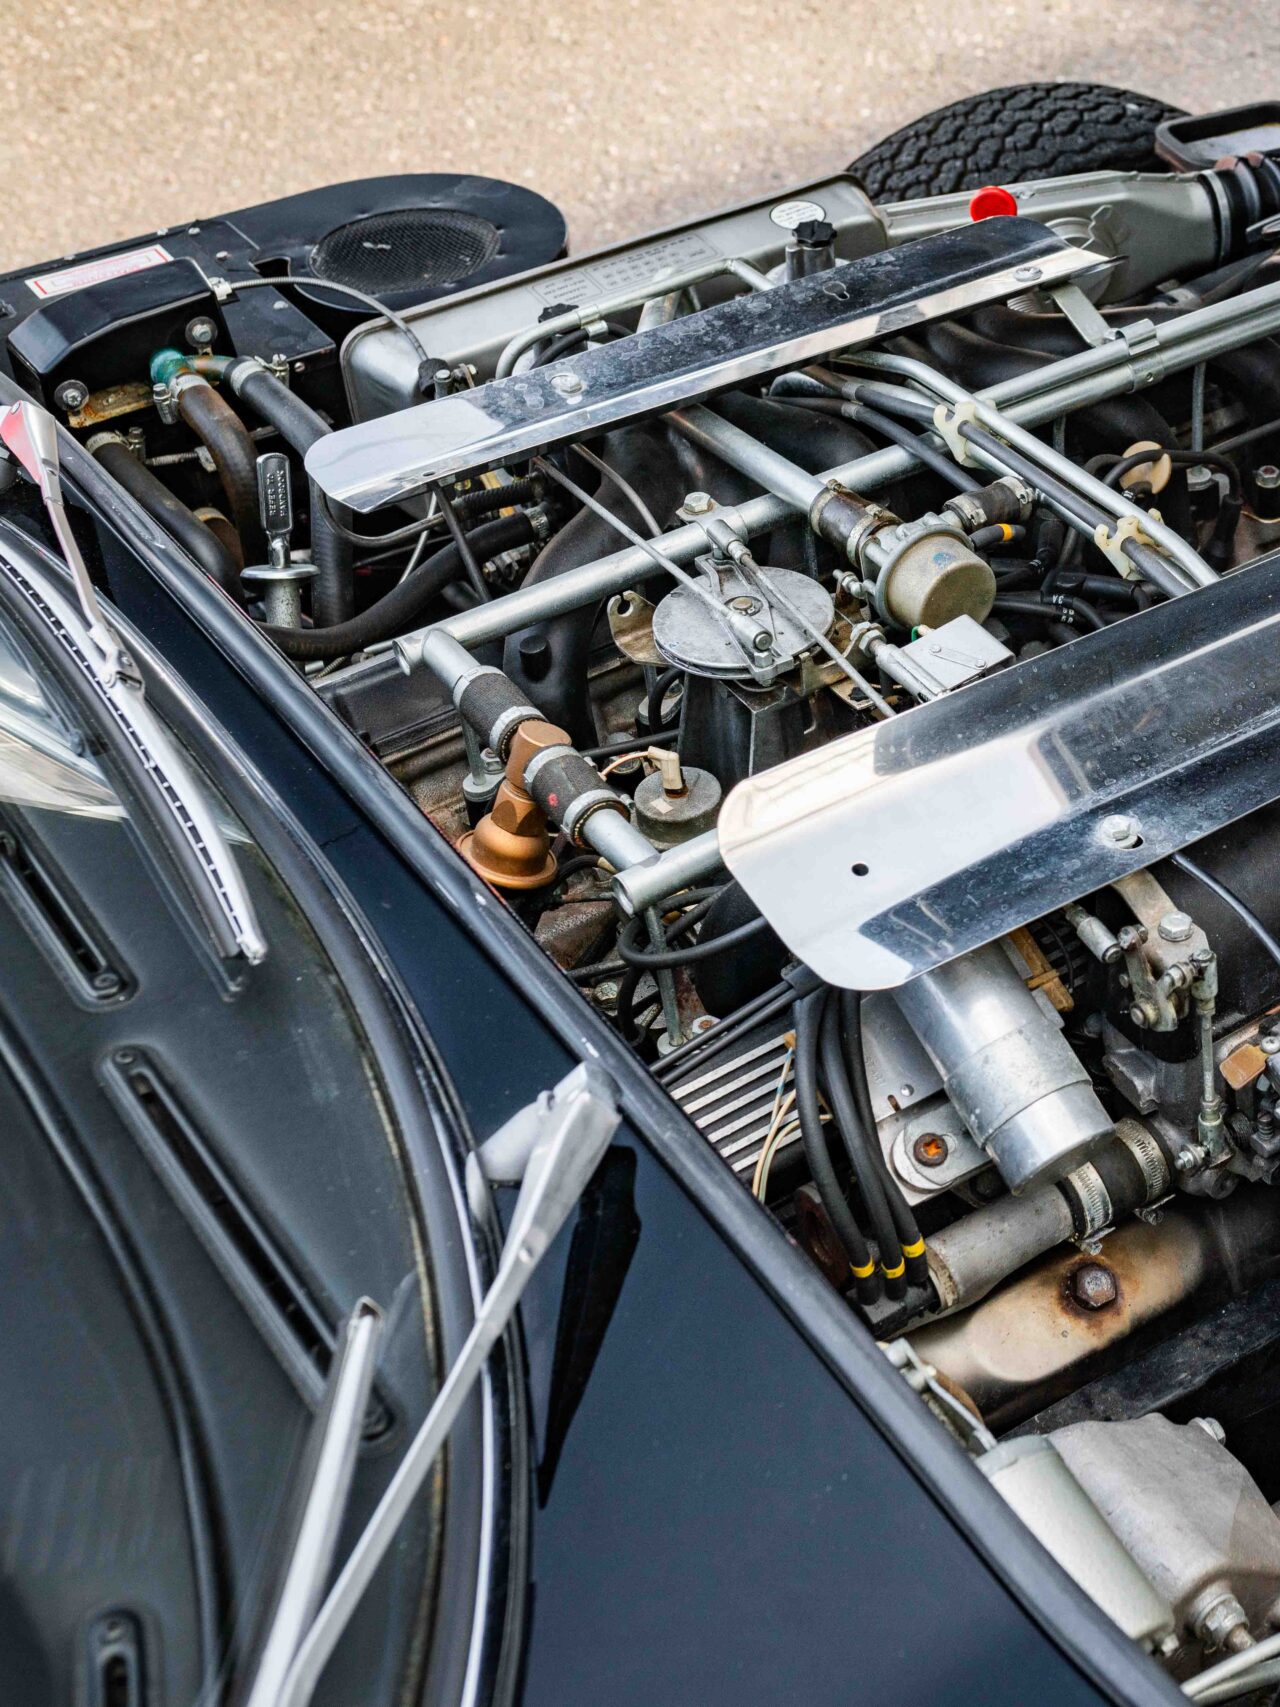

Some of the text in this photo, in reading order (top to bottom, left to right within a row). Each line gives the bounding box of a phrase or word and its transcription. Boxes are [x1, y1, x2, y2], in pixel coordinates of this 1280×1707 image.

[266, 473, 276, 516] REFER TO
[276, 470, 287, 516] HANDBOOK
